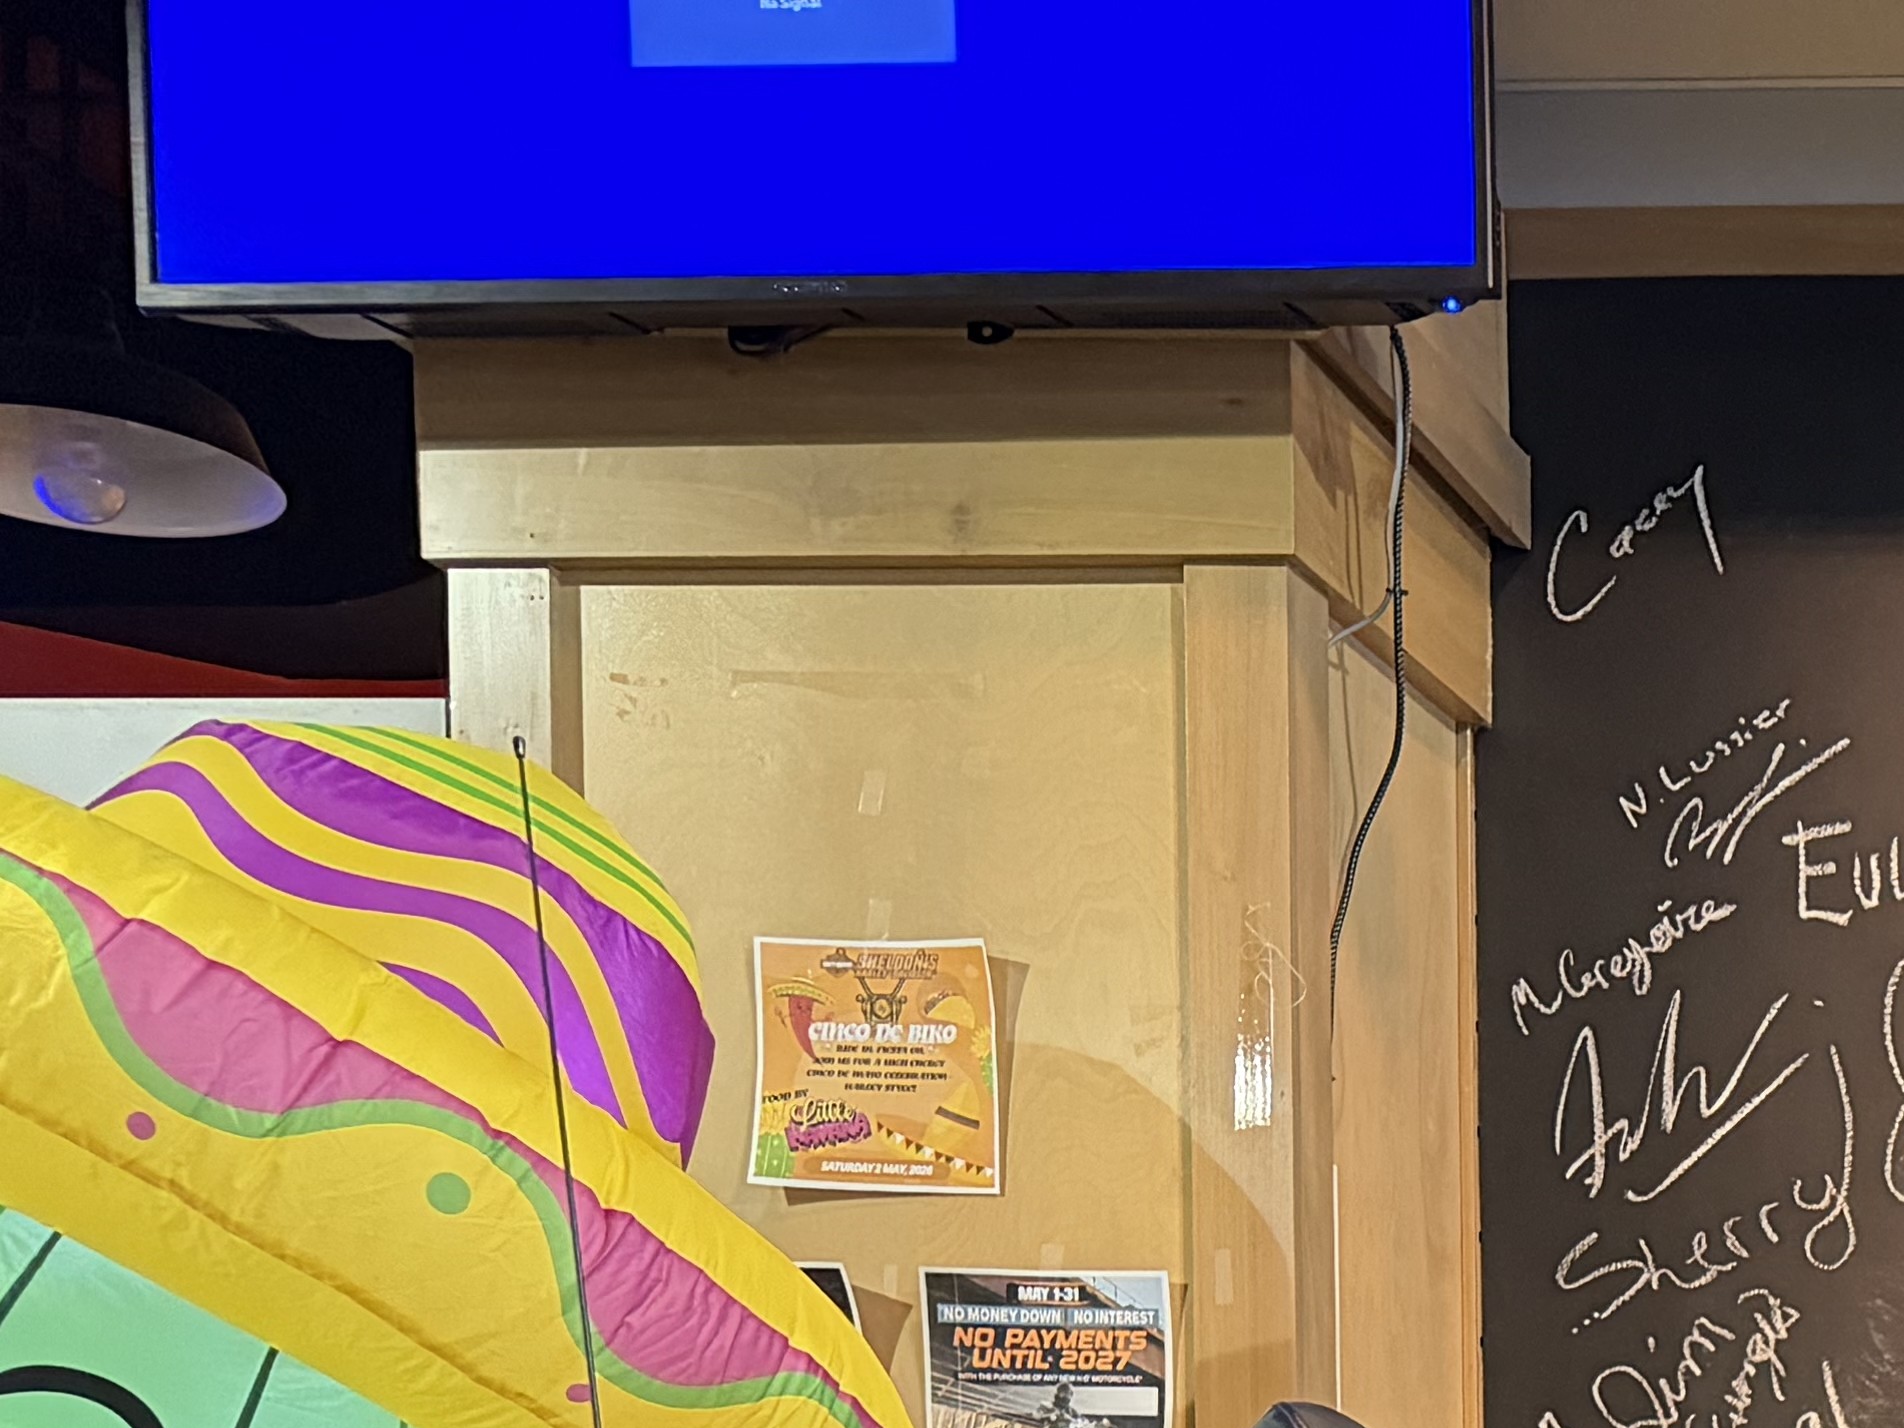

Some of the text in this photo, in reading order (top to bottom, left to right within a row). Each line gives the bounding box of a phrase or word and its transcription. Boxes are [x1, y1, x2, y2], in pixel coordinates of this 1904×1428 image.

[820, 1160, 875, 1175] SATURDAY
[1017, 1286, 1080, 1301] MAY 1-31
[943, 1307, 1156, 1326] NO MONEY DOWN NO INTEREST
[952, 1326, 1148, 1350] NO PAYMENTS
[1059, 1350, 1133, 1372] 2027
